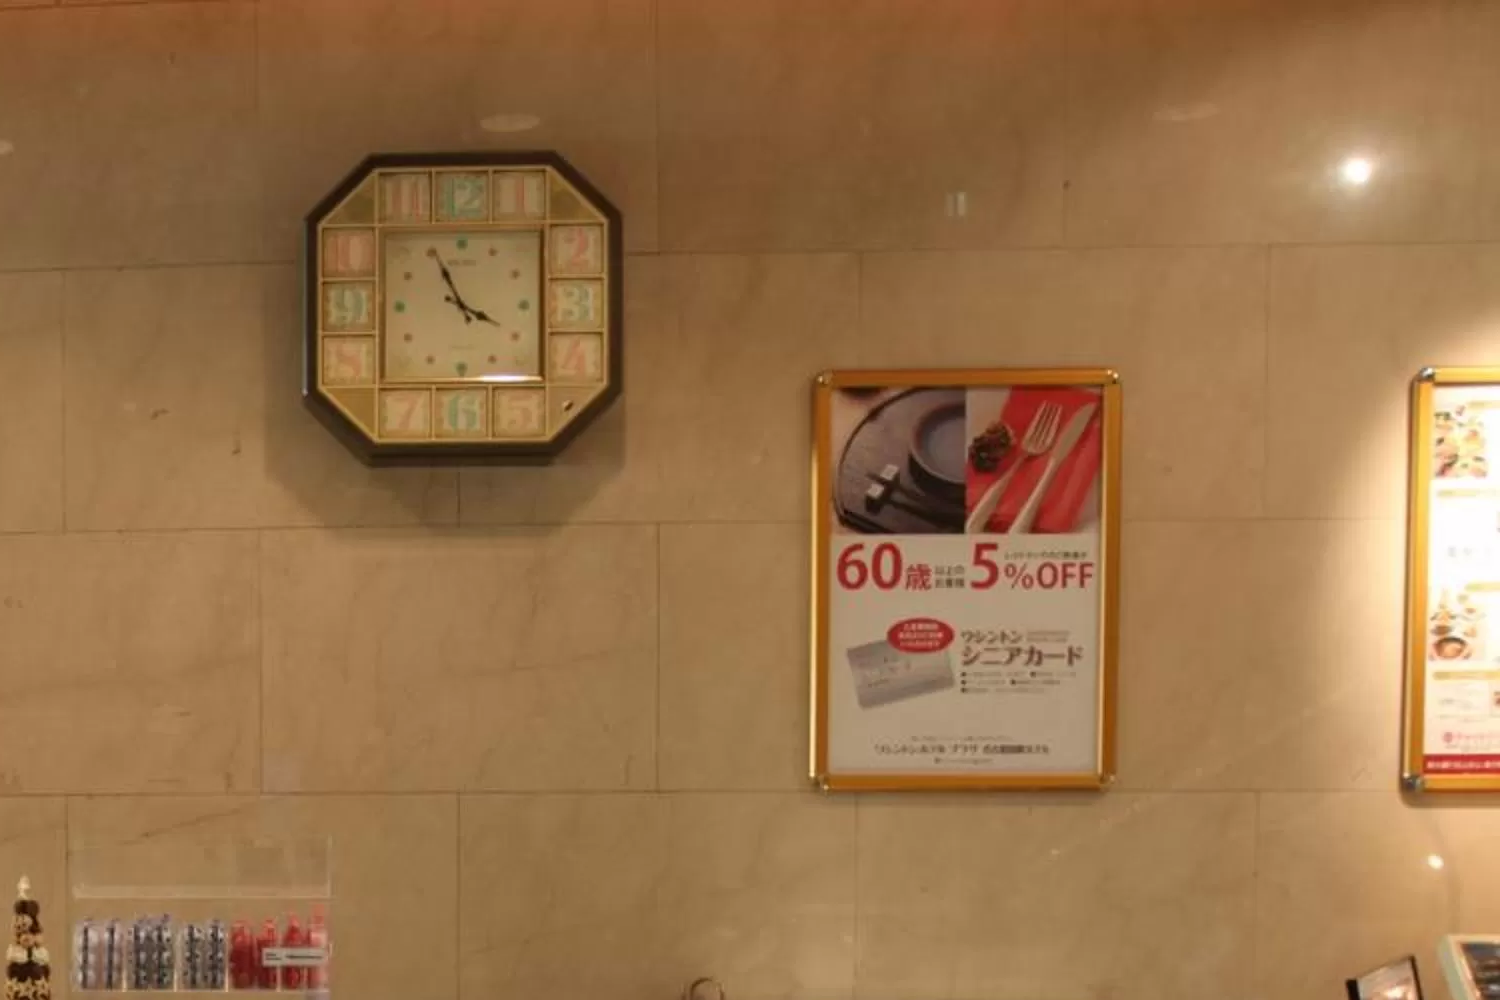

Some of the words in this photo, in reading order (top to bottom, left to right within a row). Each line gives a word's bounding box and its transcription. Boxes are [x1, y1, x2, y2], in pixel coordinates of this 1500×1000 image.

[445, 178, 484, 218] 12
[328, 235, 368, 271] 10
[563, 228, 592, 265] 2
[334, 286, 366, 327] 9
[563, 285, 592, 322] 3
[391, 392, 418, 430] 7
[448, 392, 478, 431] 6
[508, 393, 534, 430] 5
[836, 541, 932, 591] 60歳
[961, 629, 1023, 644] ワシントン
[961, 645, 1085, 667] シニアカード
